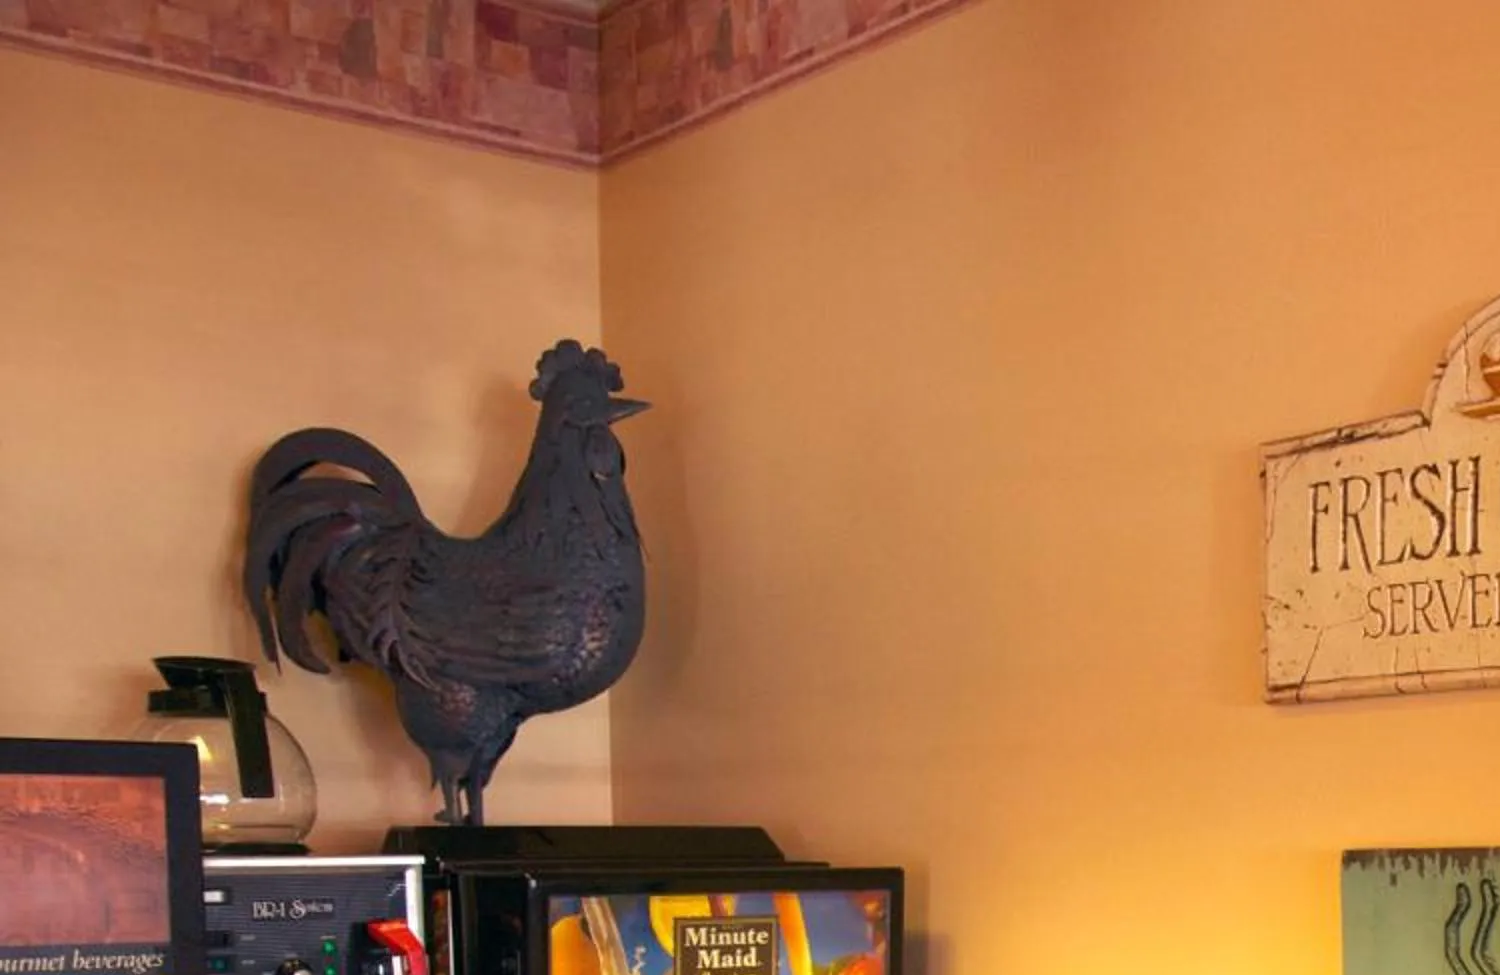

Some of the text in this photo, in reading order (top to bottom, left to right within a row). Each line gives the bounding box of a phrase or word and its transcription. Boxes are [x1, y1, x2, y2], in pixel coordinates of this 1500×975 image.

[1308, 455, 1482, 575] FRESH
[684, 927, 769, 947] Minute
[72, 949, 166, 975] beverages
[697, 947, 758, 969] Maid
